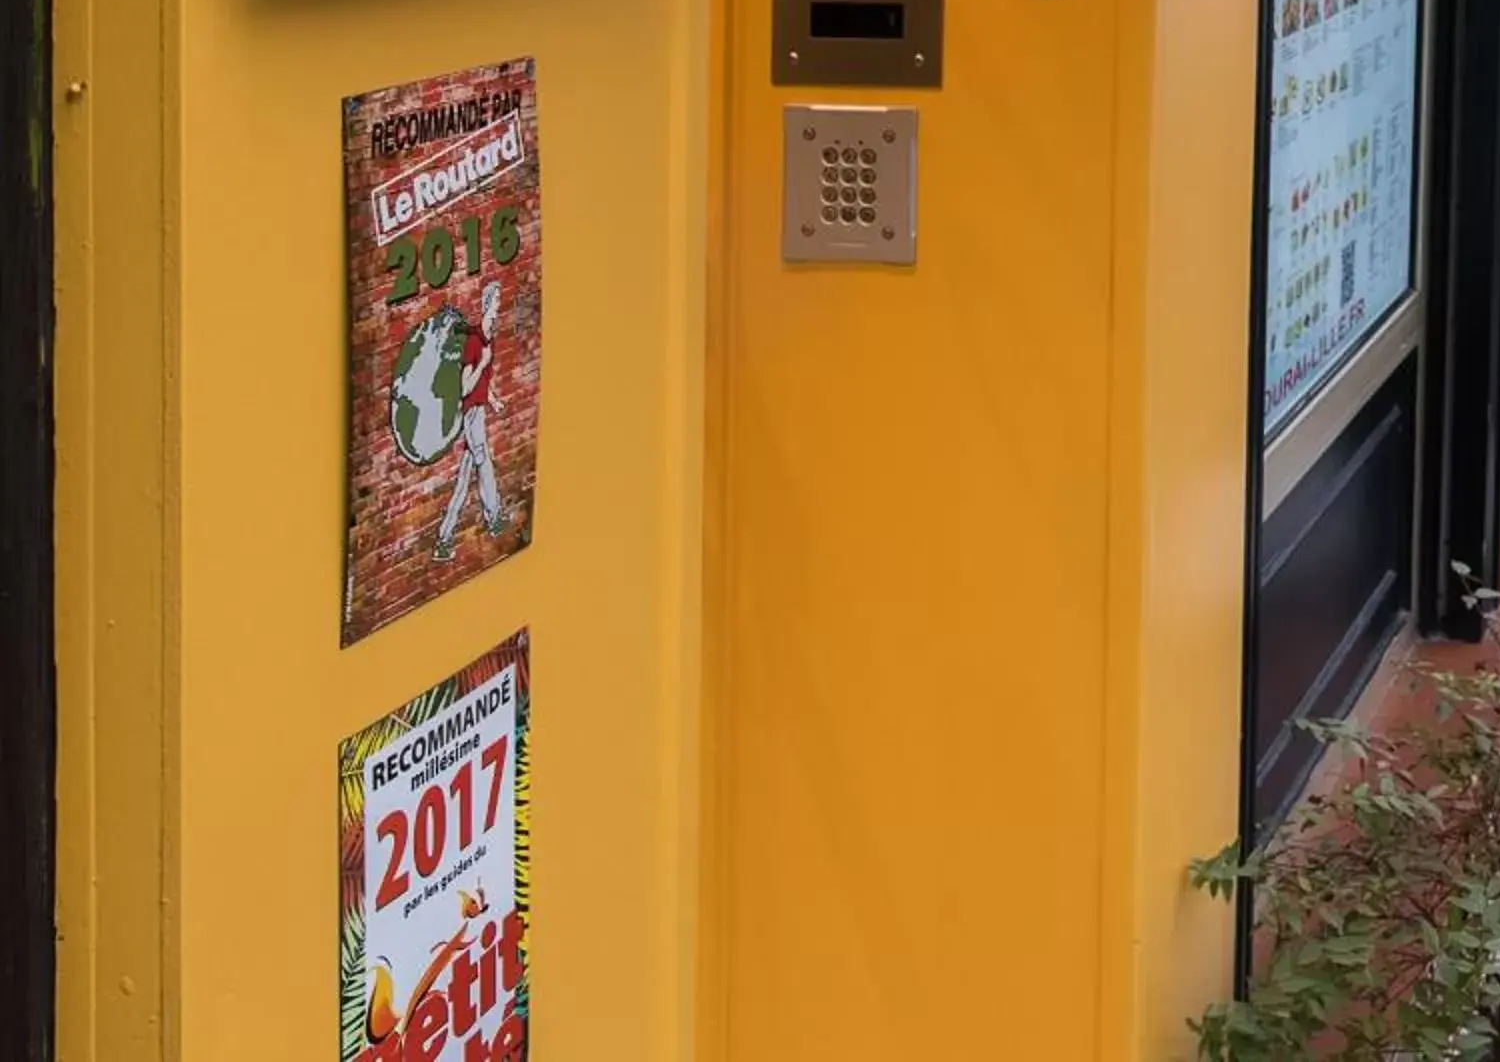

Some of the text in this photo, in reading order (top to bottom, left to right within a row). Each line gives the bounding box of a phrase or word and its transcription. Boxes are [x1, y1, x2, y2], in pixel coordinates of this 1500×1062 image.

[492, 90, 522, 122] PAR
[379, 123, 518, 232] Le Routard
[386, 207, 521, 305] 2016
[372, 674, 511, 791] RECOMMANDÉ
[411, 733, 481, 792] millésime
[375, 734, 509, 912] 2017
[403, 845, 487, 919] par les guides du
